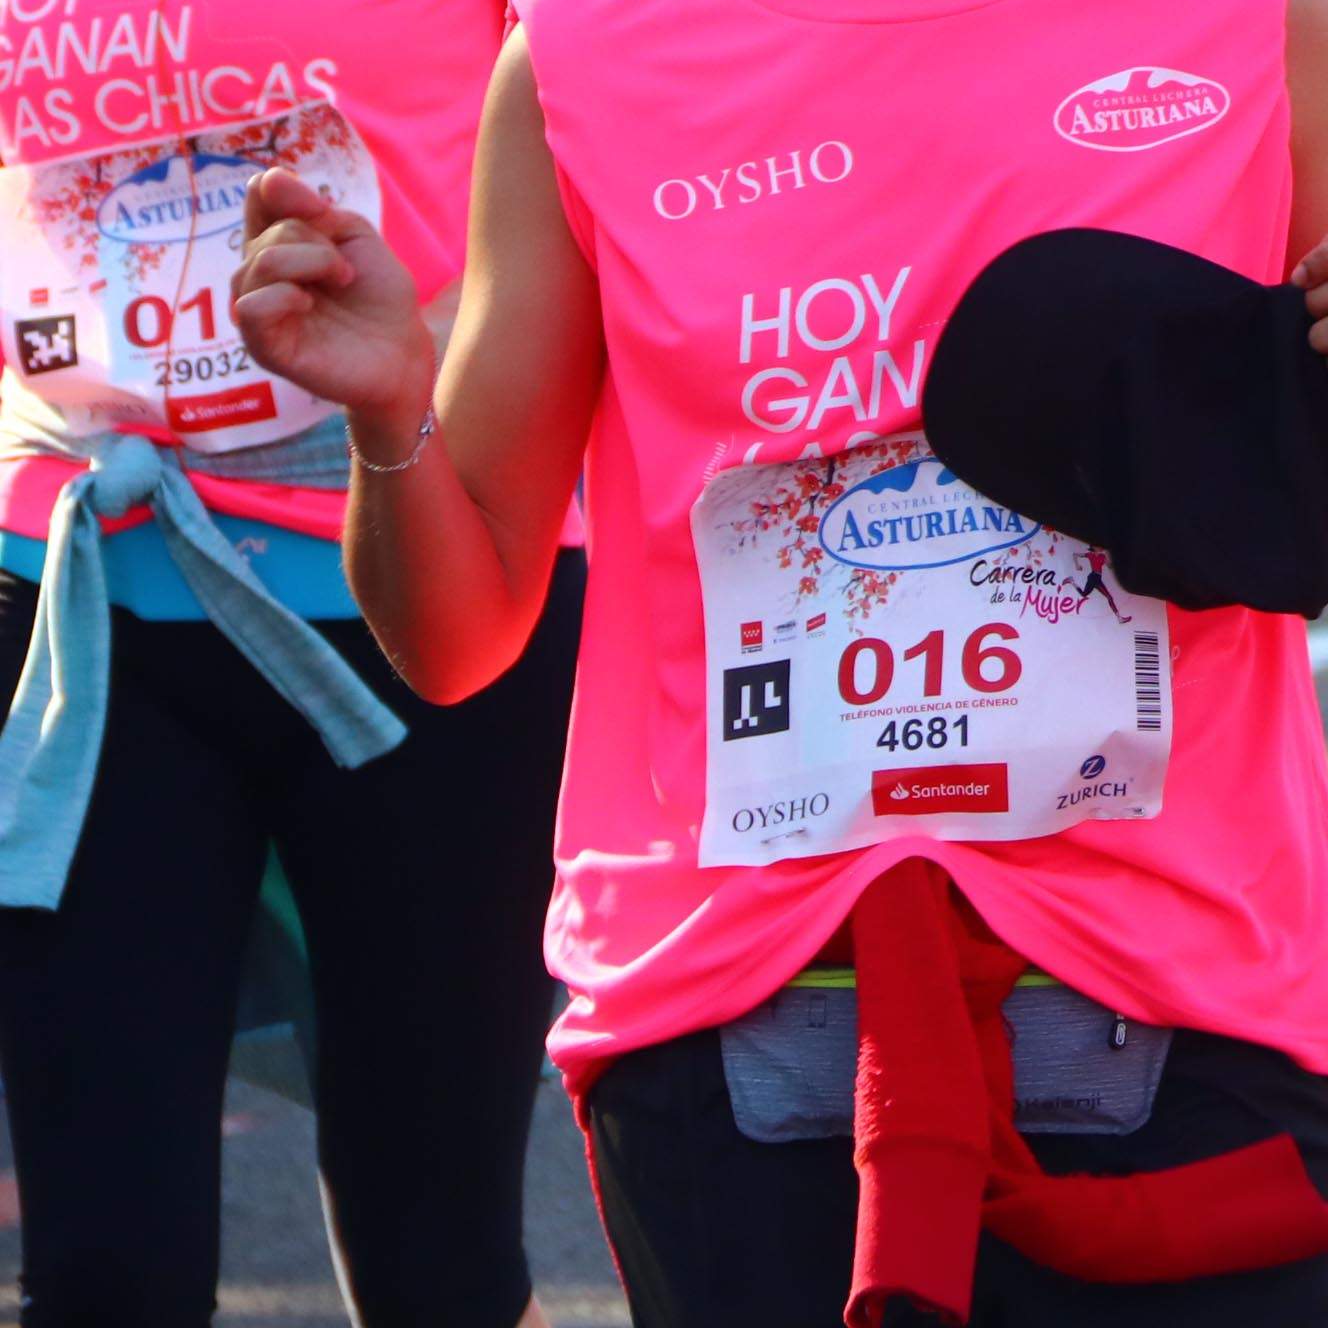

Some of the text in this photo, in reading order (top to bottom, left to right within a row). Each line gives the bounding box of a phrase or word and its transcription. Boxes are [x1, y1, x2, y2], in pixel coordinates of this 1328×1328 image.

[94, 58, 338, 135] CHICAS
[1069, 96, 1218, 136] ASTURIANA
[1093, 95, 1149, 108] CENTRAL
[652, 139, 854, 221] OYSHO
[113, 182, 248, 232] ASTURIAN
[123, 286, 240, 348] 01
[738, 265, 913, 365] HOY
[195, 396, 261, 419] Santander
[738, 339, 925, 434] GAN
[867, 495, 936, 514] CENTRAL
[837, 505, 1026, 553] ASTURIANA
[969, 559, 1057, 587] Carrera
[990, 583, 1090, 625] de la Mujer
[837, 622, 1023, 706] 016
[839, 697, 1018, 722] TELÉFONO VIOLENCIA DE GÉNERO
[876, 714, 969, 752] 4681
[911, 782, 990, 799] Santander
[1056, 781, 1128, 811] ZURICH
[731, 791, 831, 834] OYSHO
